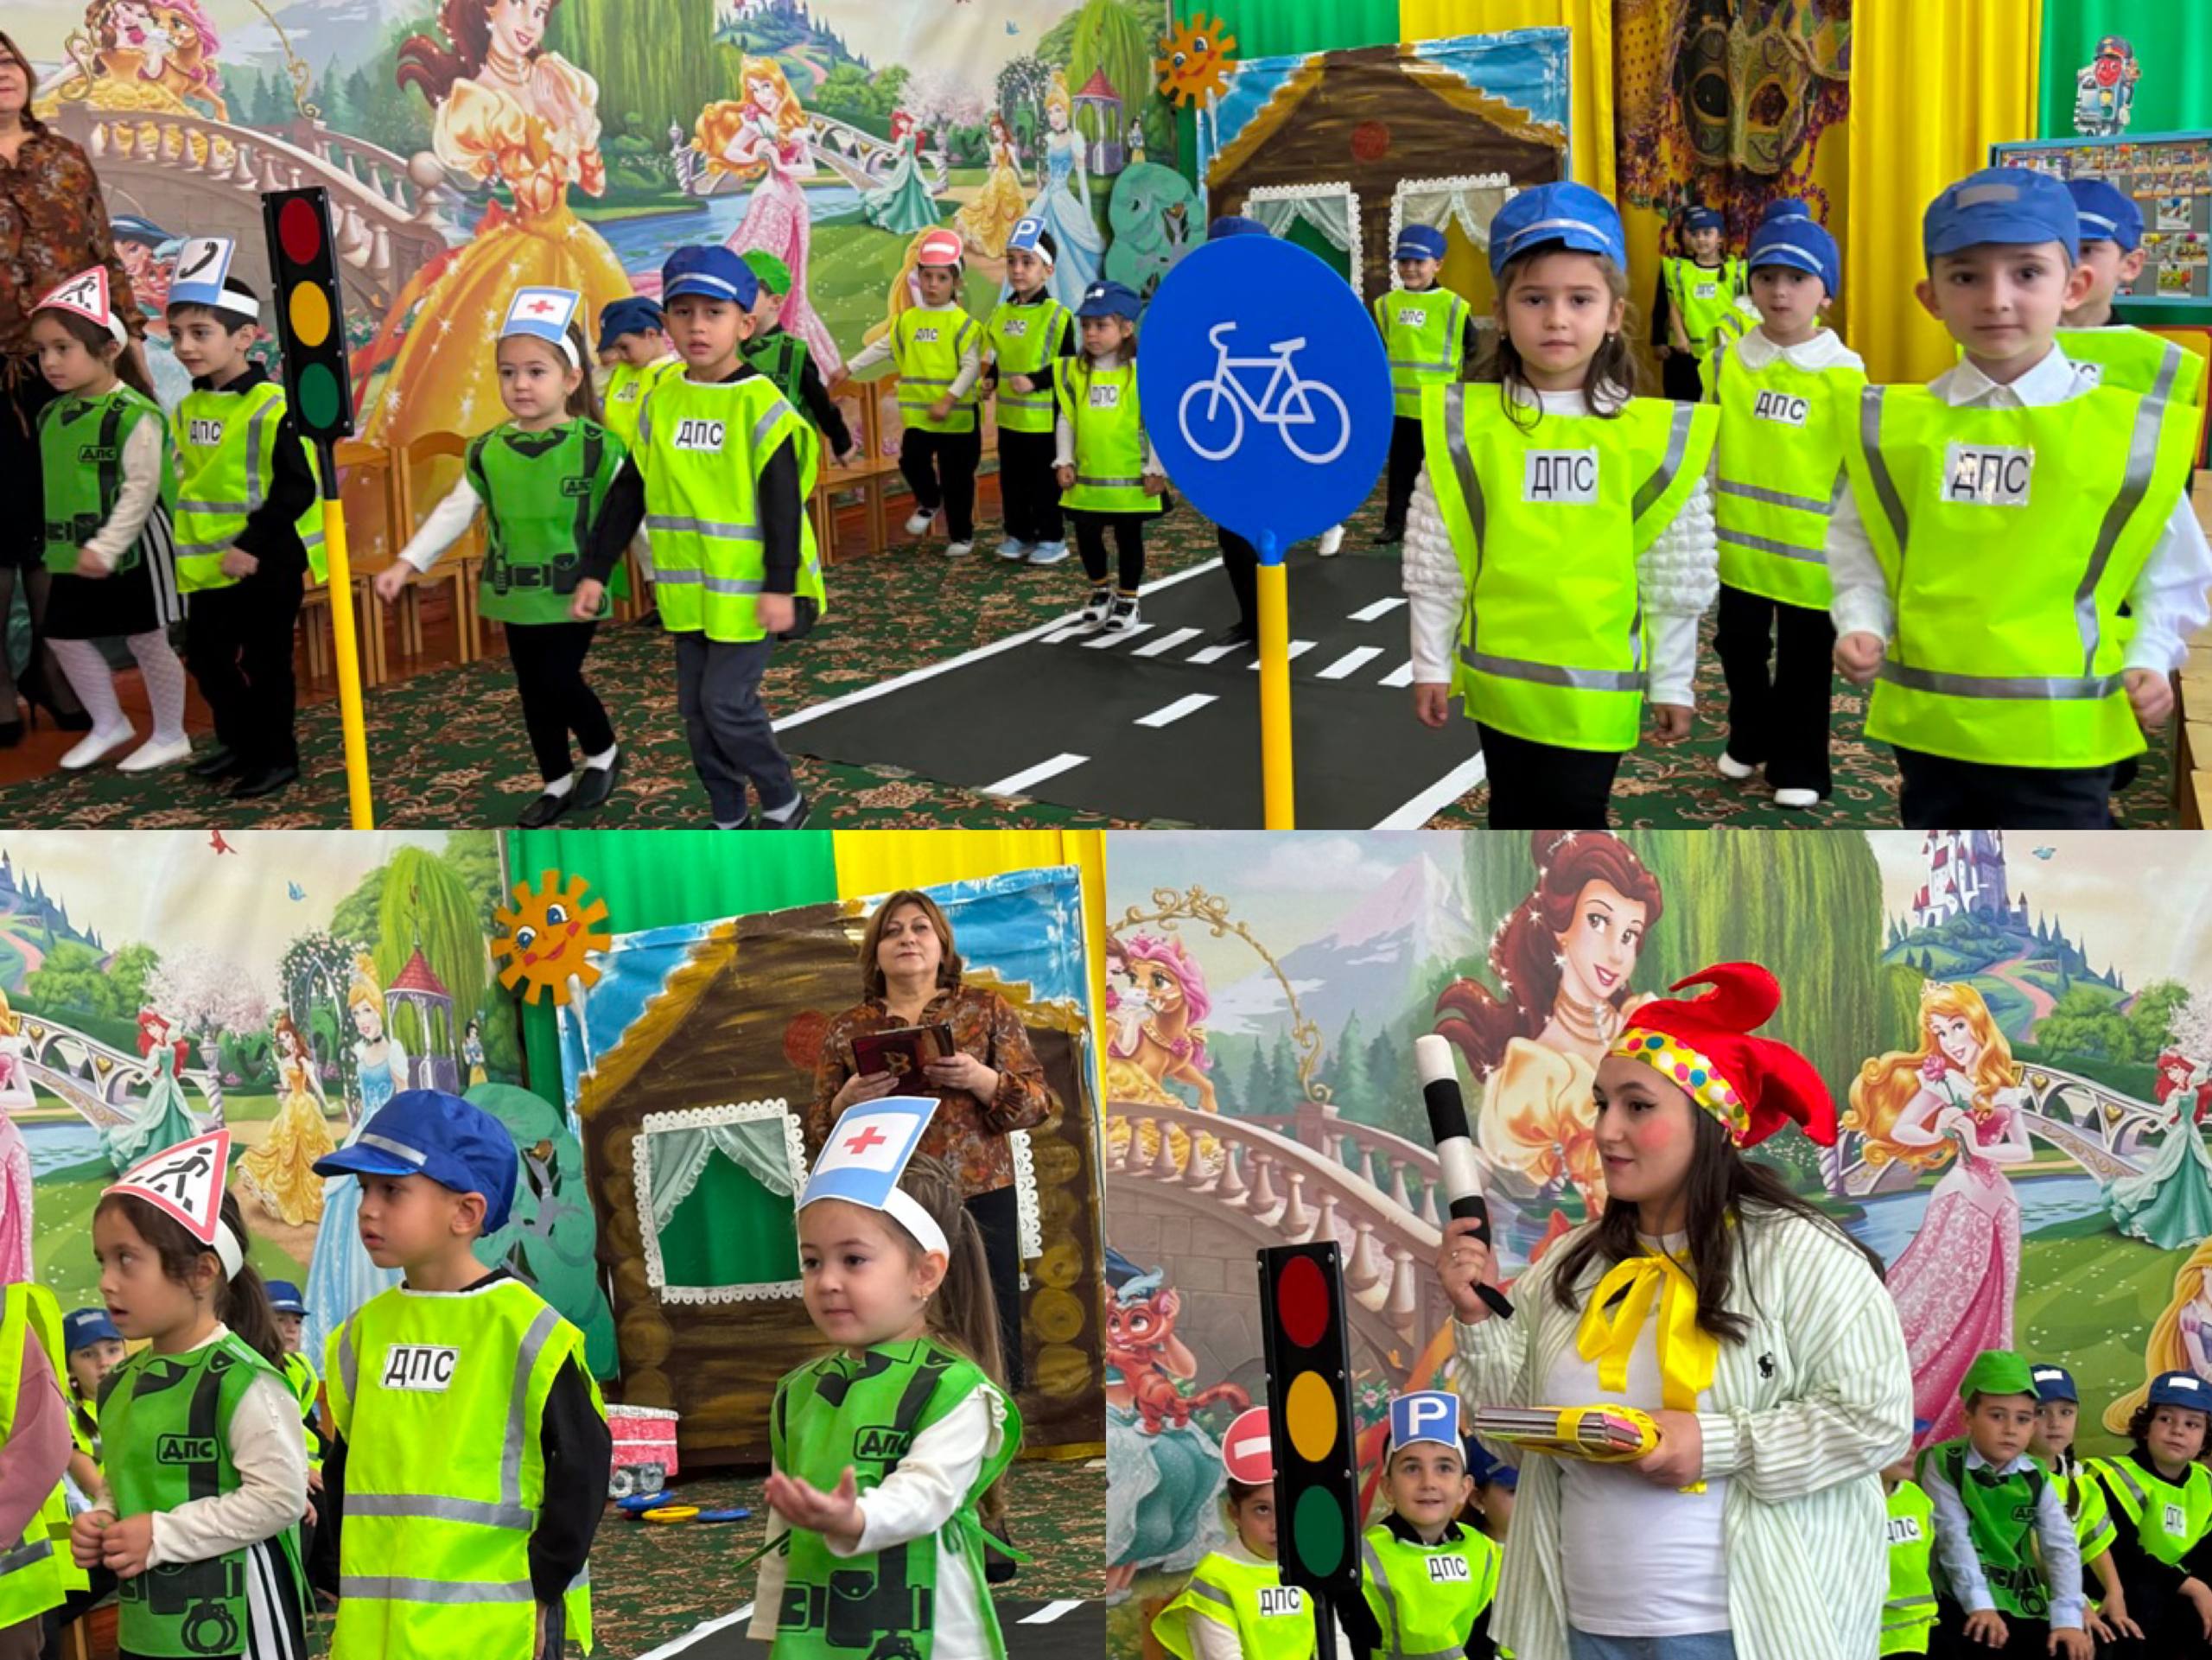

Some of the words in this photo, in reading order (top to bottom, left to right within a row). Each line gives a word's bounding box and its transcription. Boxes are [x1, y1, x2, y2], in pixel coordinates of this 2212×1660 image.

[1011, 220, 1036, 243] P
[1400, 310, 1424, 324] ДПС
[914, 328, 938, 342] ДПС
[1755, 391, 1805, 421] ДПС
[189, 420, 221, 442] ДПС
[677, 421, 723, 447] ДПС
[81, 448, 116, 460] ДПС
[1532, 455, 1595, 499] ДПС
[1951, 452, 2028, 499] ДПС
[385, 1349, 455, 1386] ДПС
[1408, 1397, 1448, 1435] P
[162, 1439, 214, 1460] ДПС
[1430, 1557, 1467, 1580] ДПС
[1262, 1588, 1300, 1615] ДПС
